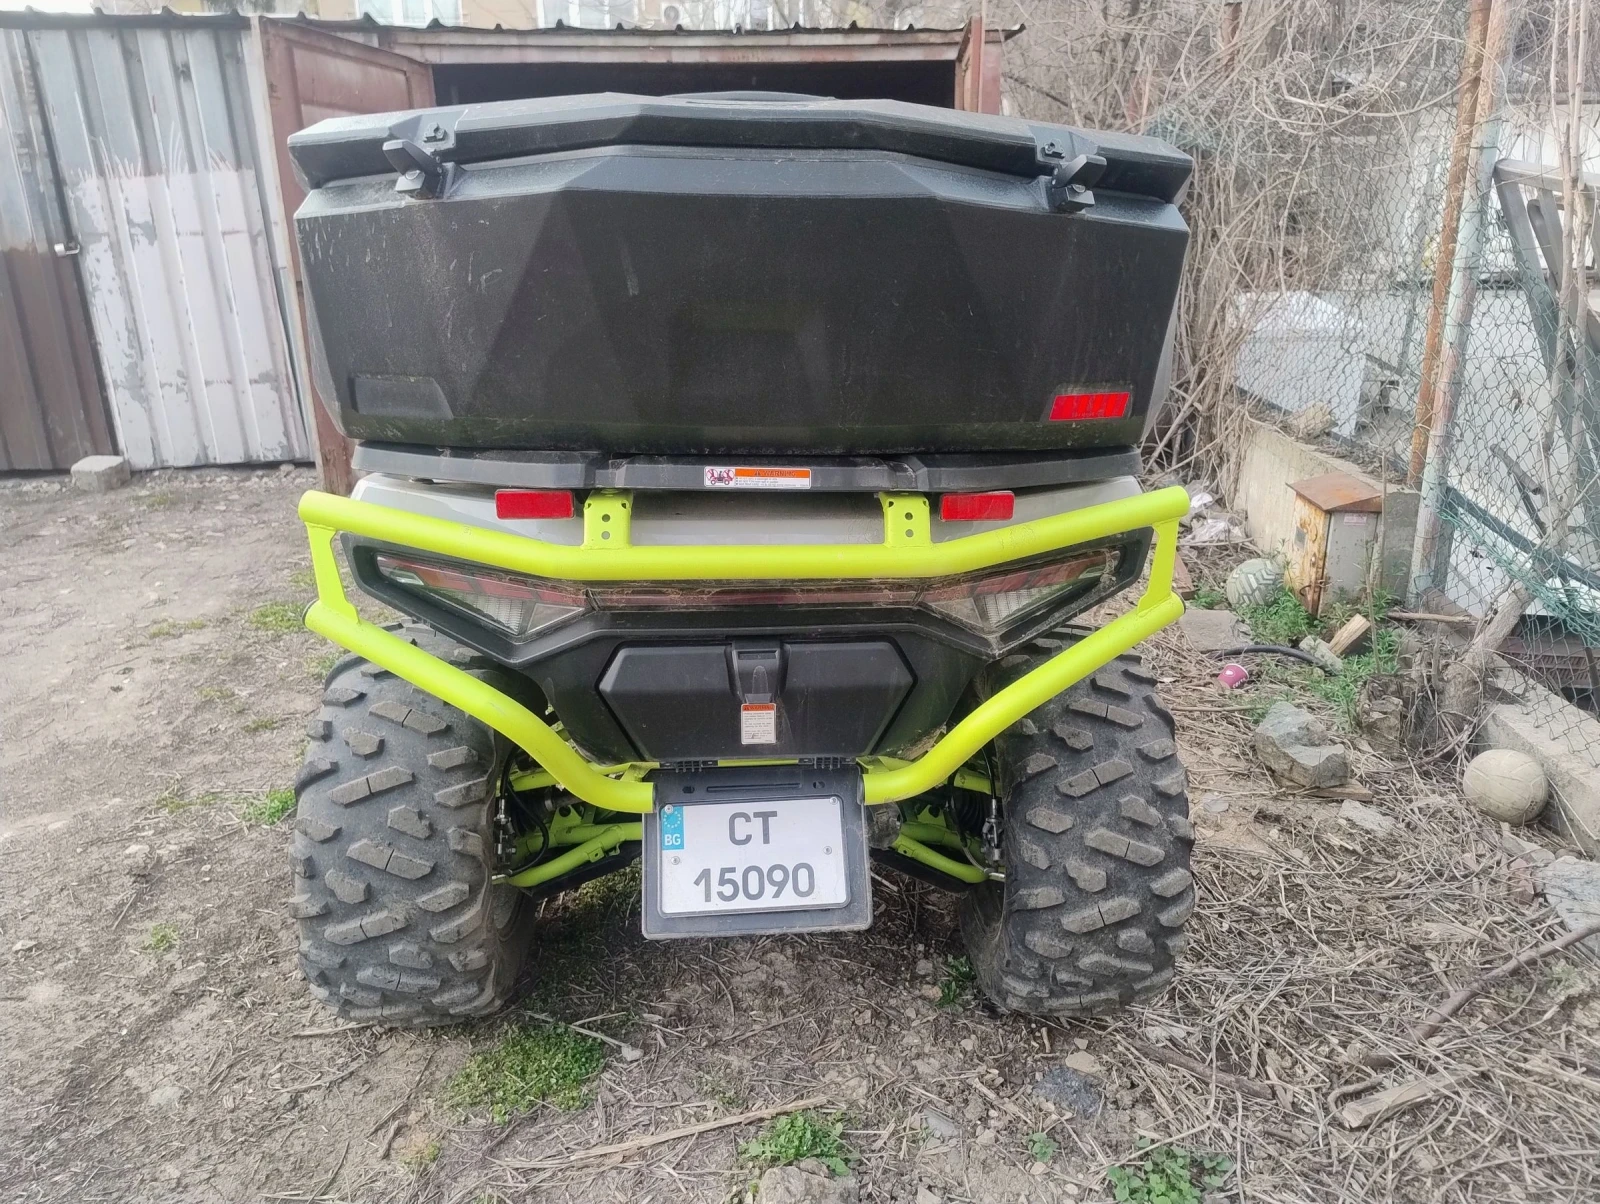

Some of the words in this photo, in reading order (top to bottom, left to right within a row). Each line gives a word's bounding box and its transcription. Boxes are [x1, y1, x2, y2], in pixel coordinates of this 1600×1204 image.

[664, 834, 681, 846] BG
[728, 811, 778, 846] CT
[693, 862, 815, 903] 15090
